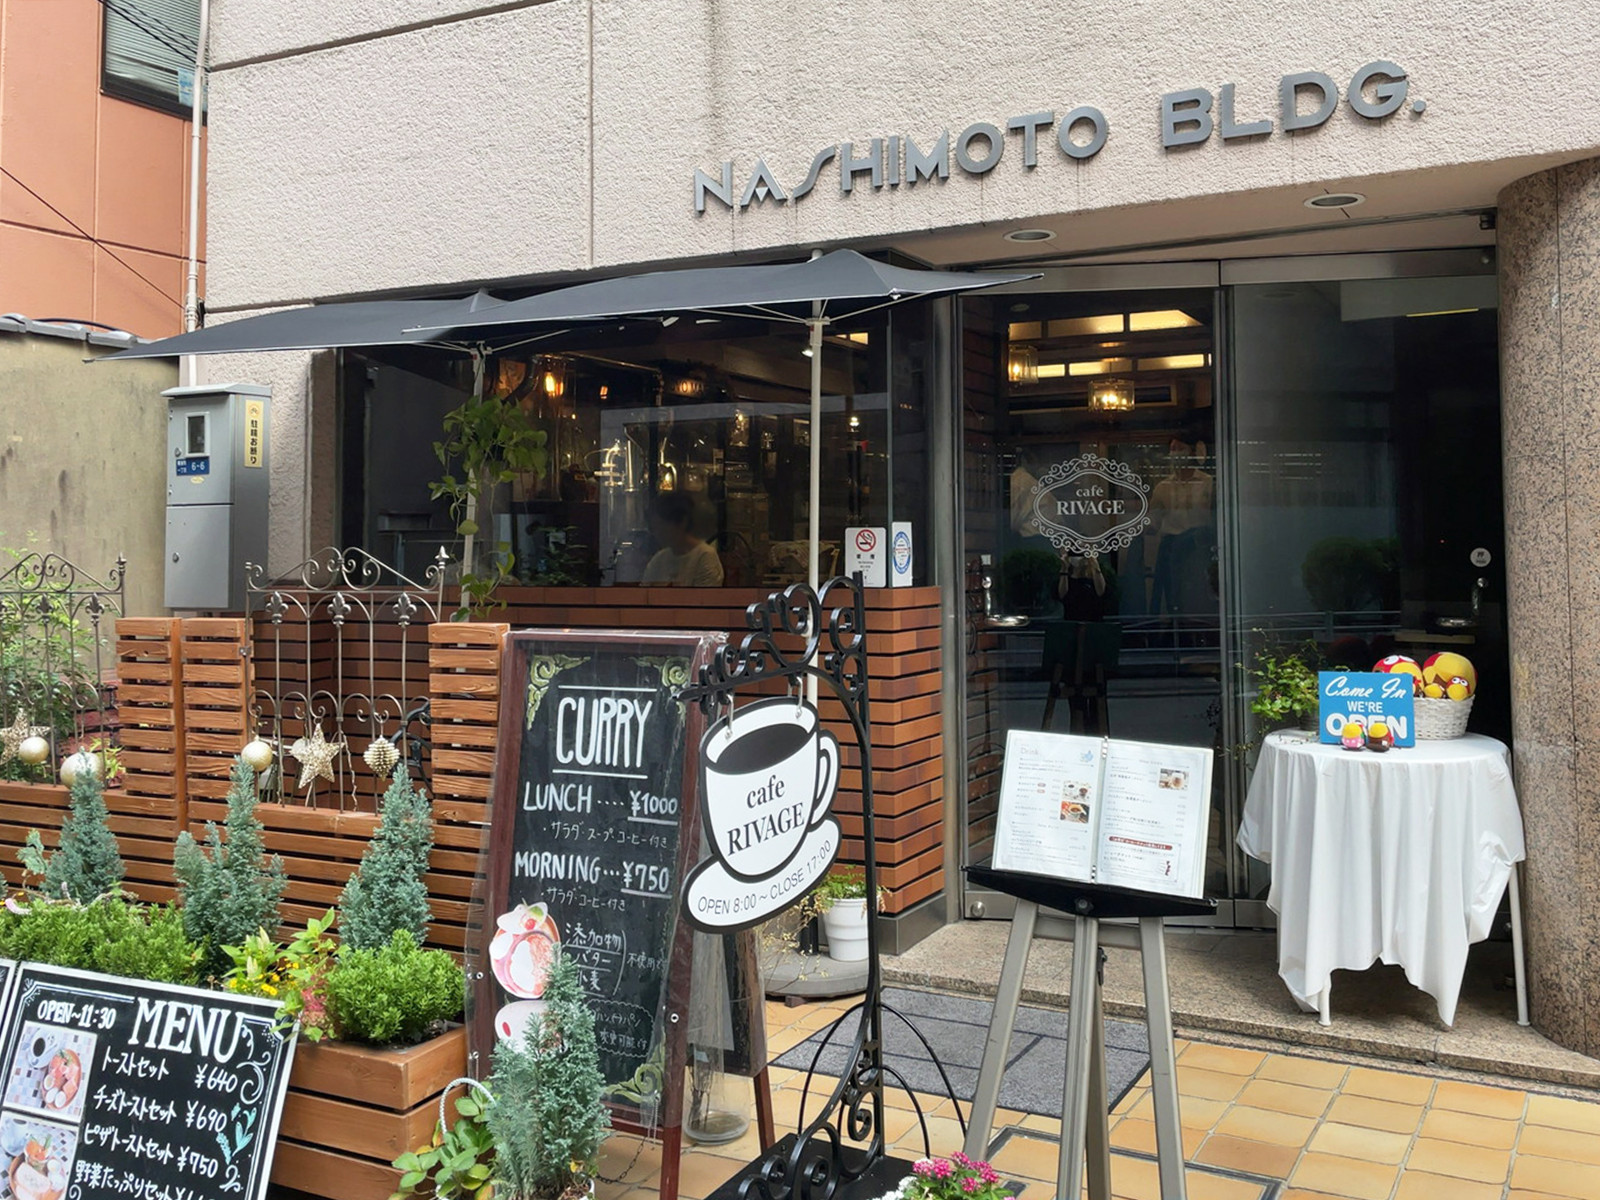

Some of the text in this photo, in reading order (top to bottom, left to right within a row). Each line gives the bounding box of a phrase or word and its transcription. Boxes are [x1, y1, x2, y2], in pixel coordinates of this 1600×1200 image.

[693, 60, 1427, 213] NASHIMOTO BLDG.
[191, 461, 205, 471] 6-6
[1056, 500, 1125, 516] RIVAGE
[1325, 676, 1407, 699] Come In
[1347, 701, 1383, 714] WE'RE
[555, 697, 653, 768] CURRY
[523, 781, 678, 817] LUNCH ¥1000
[746, 774, 785, 809] cafe
[727, 802, 805, 856] RIVAGE
[514, 851, 669, 892] MORNING ¥750
[698, 896, 731, 915] OPEN
[806, 839, 832, 875] 17:00
[128, 997, 245, 1064] MENU
[102, 1045, 238, 1093] トーストセット ¥640
[93, 1084, 227, 1133] チーズトーストセット ¥690
[84, 1122, 218, 1178] ピザトーストセット ¥750
